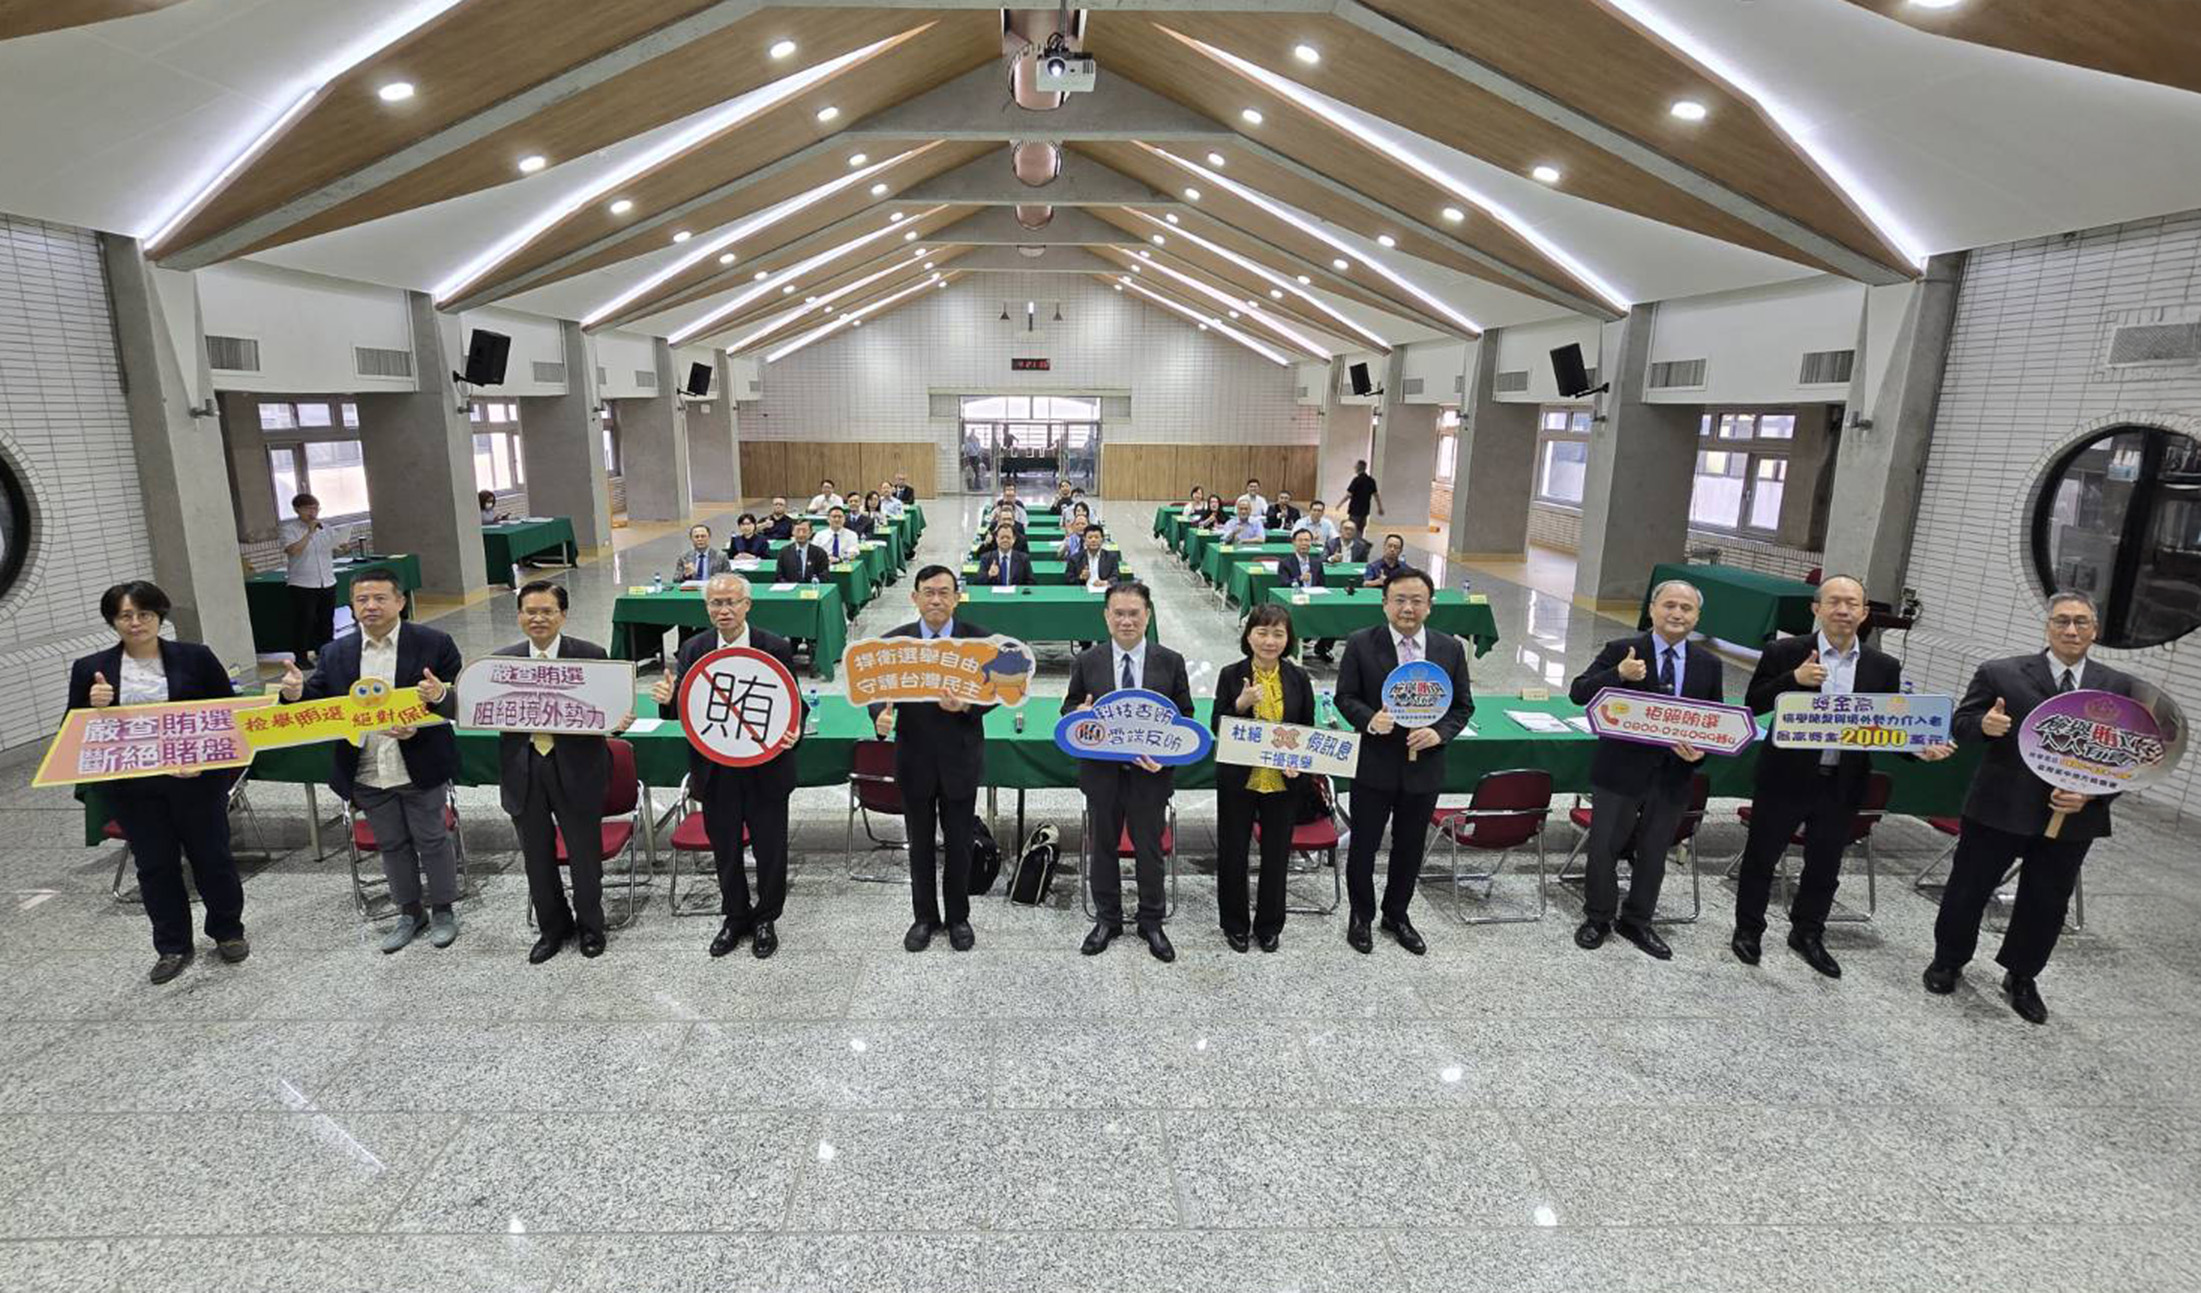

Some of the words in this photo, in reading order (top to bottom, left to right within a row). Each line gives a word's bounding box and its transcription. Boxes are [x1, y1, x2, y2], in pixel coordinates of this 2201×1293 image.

[854, 647, 980, 675] 捍衛選舉自由
[857, 672, 981, 698] 守護台灣民主
[473, 700, 606, 730] 阻絕境外勢力
[701, 671, 778, 742] 賄
[1645, 705, 1720, 728] 拒絕賄選
[85, 708, 235, 743] 嚴查賄選
[78, 736, 239, 774] 斷絕賭盤
[1231, 724, 1263, 743] 杜絕
[1306, 731, 1353, 761] 假訊息
